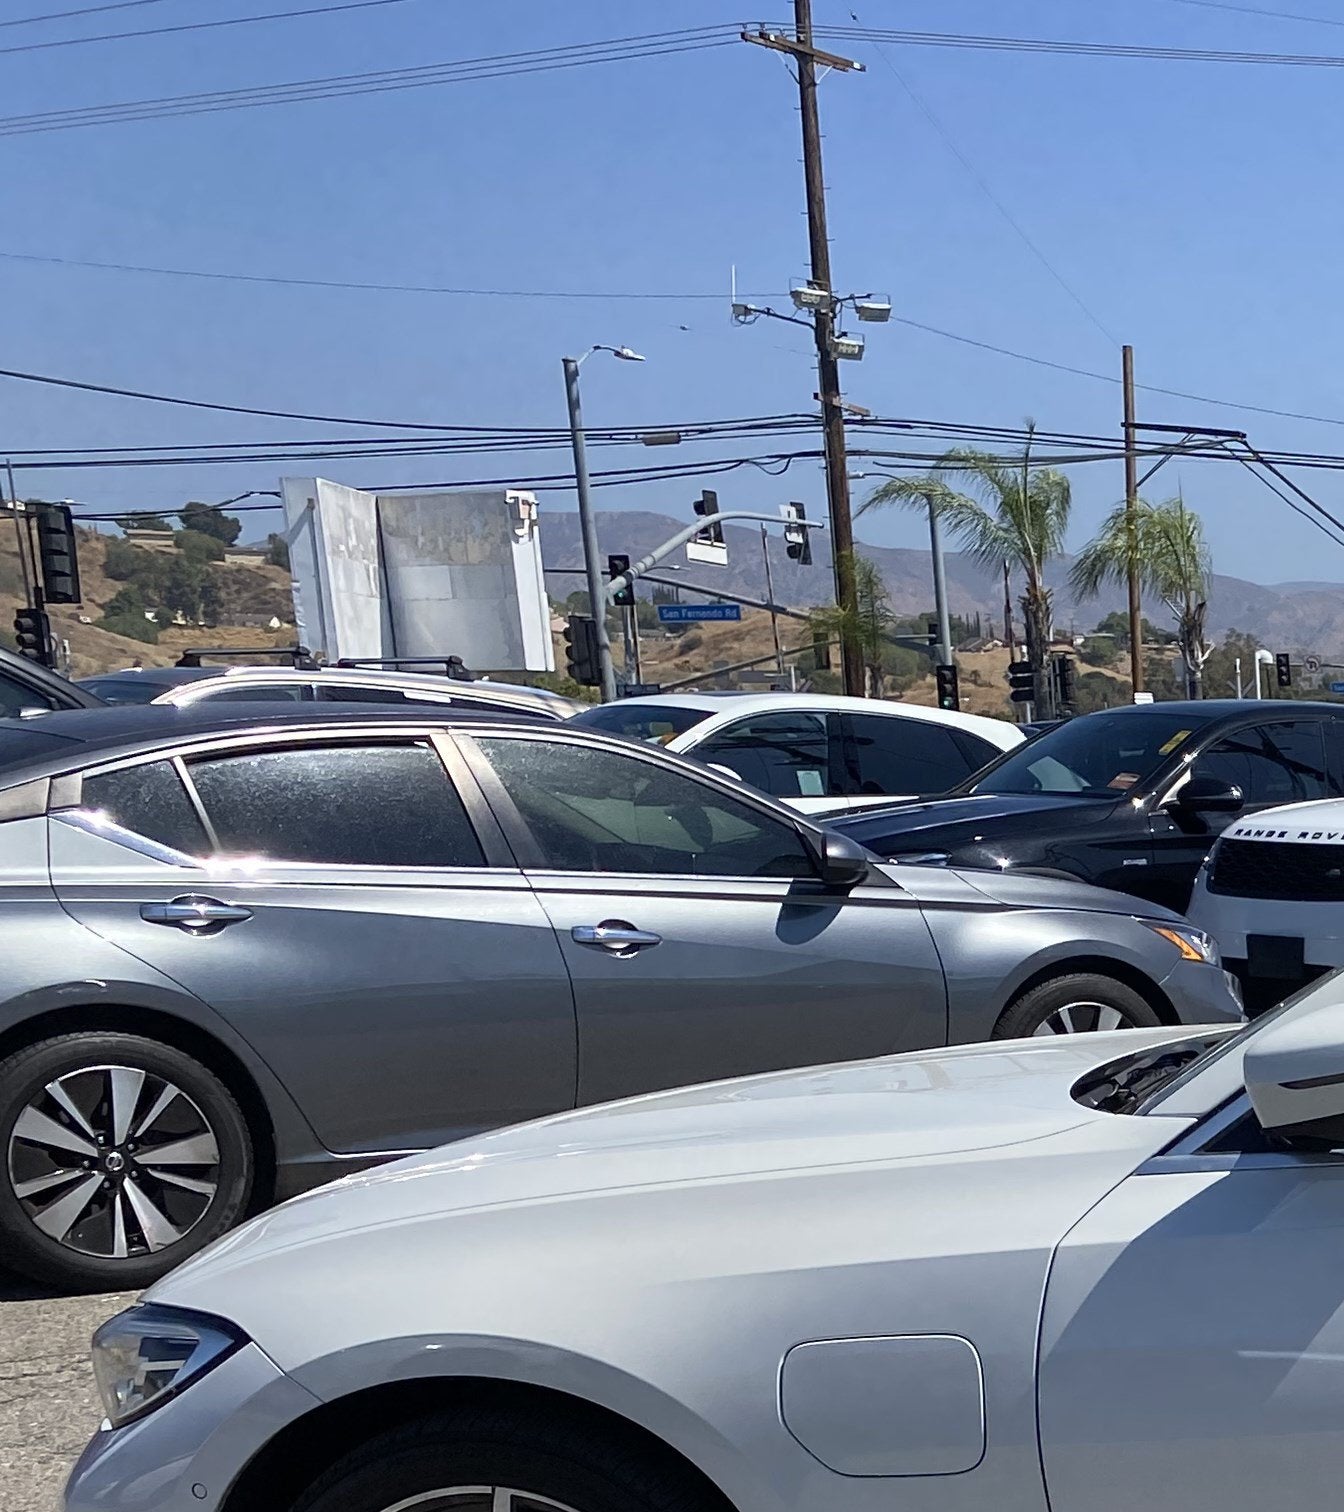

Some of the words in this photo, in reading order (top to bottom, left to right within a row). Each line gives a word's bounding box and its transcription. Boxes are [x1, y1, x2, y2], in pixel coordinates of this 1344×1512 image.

[662, 608, 680, 618] San
[681, 608, 723, 618] Fernando
[725, 608, 737, 618] Rd
[1234, 828, 1288, 838] RANGE
